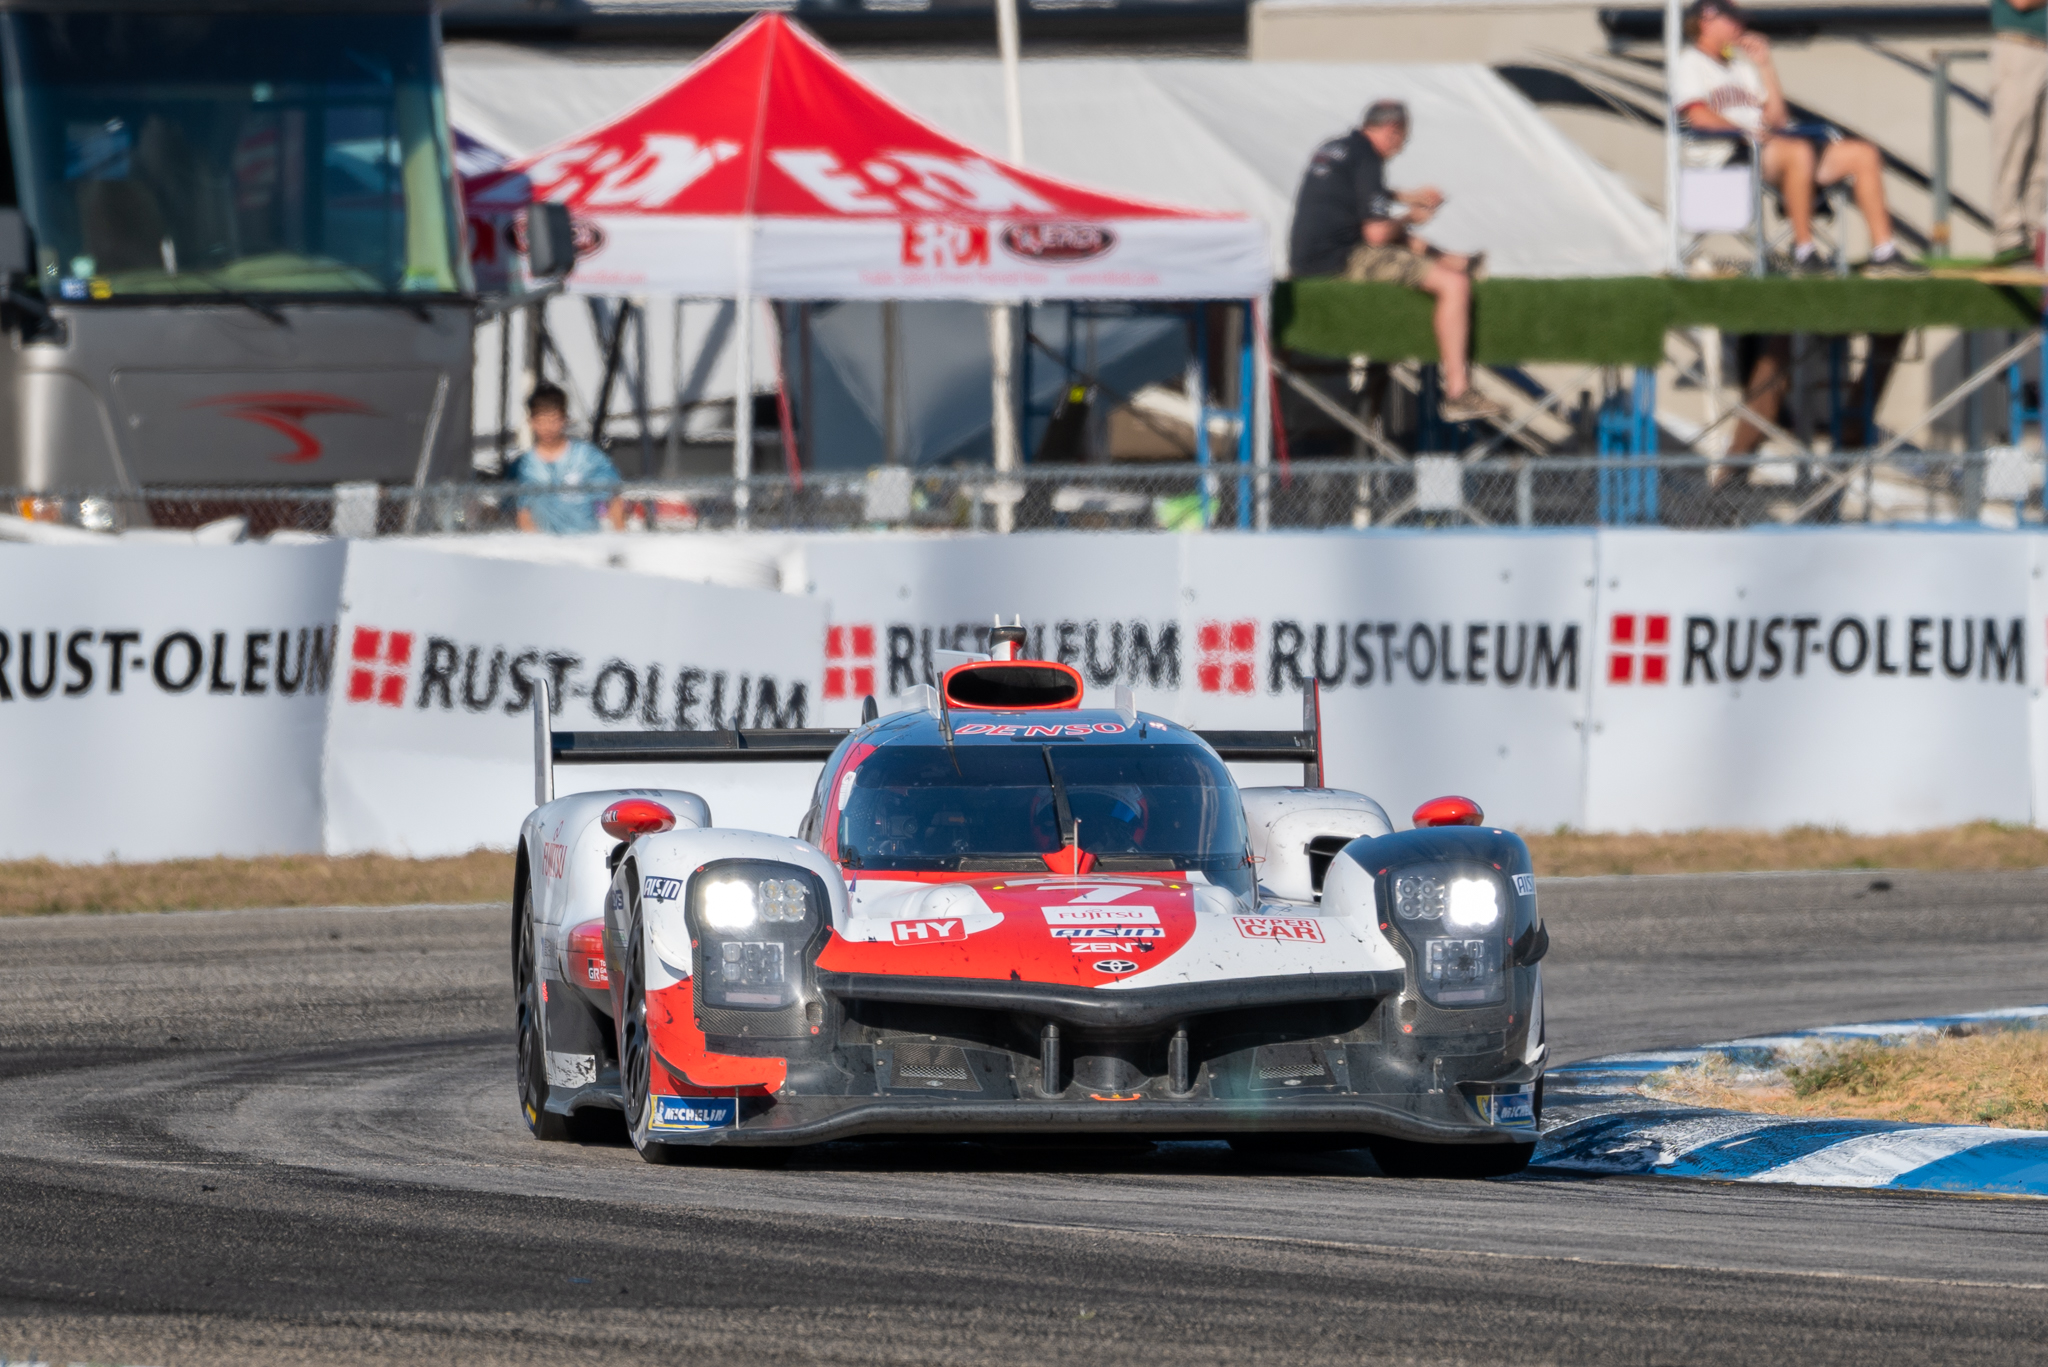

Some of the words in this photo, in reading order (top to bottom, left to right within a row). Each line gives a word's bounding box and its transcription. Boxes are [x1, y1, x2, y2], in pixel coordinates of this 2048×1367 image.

[1266, 620, 1579, 694] RUST-OLEUM
[1682, 615, 2026, 686] RUST-OLEUM
[954, 723, 1126, 737] DENSO
[643, 877, 681, 899] AISIN
[1036, 884, 1143, 903] 7
[1058, 911, 1143, 921] FUJITSU
[1239, 918, 1312, 928] HYPER
[895, 920, 958, 941] HY
[1055, 928, 1161, 937] AISIN
[1244, 925, 1318, 940] CAR
[588, 967, 600, 980] GR
[664, 1107, 727, 1122] MICHELIN
